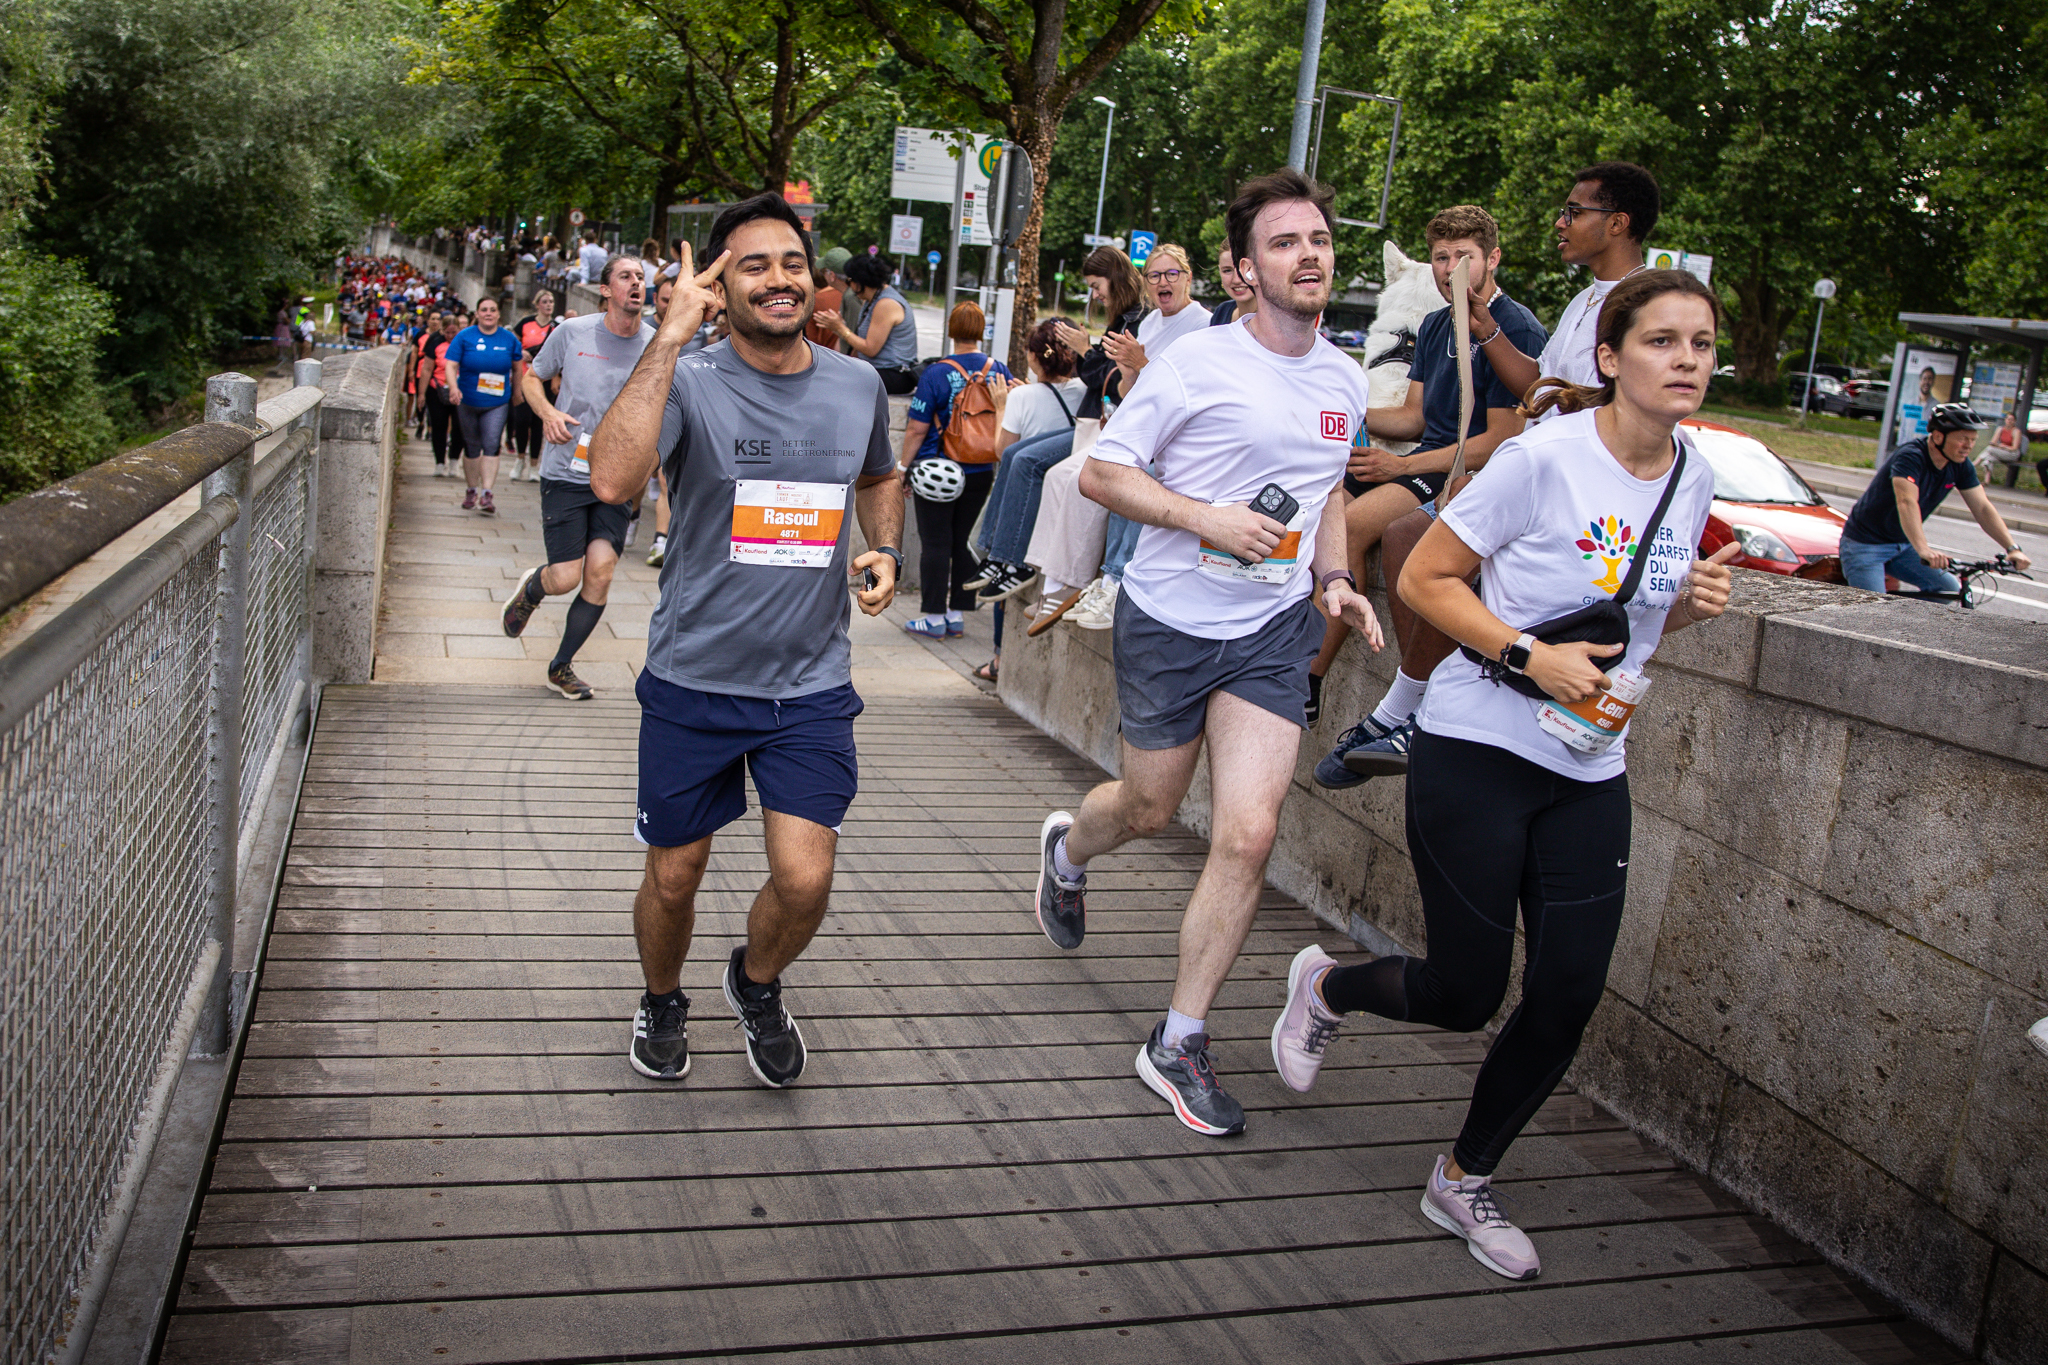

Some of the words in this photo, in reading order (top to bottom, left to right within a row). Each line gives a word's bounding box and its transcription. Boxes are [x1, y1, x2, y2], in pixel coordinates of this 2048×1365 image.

[1325, 415, 1346, 436] DB
[734, 439, 771, 457] KSE
[782, 440, 816, 448] BETTER
[782, 449, 856, 458] ELECTRONEERING
[1412, 477, 1432, 495] JAKO
[763, 508, 819, 527] Rasoul
[780, 529, 800, 539] 4871
[1655, 526, 1674, 542] IER
[774, 548, 789, 556] AOK
[1650, 543, 1690, 562] DARFST
[1210, 559, 1232, 568] Kaufland
[1650, 560, 1669, 575] DU
[1649, 577, 1677, 593] SEIN.
[1595, 694, 1628, 720] Lena
[1553, 716, 1577, 734] Kaufland
[1596, 717, 1614, 730] 4507
